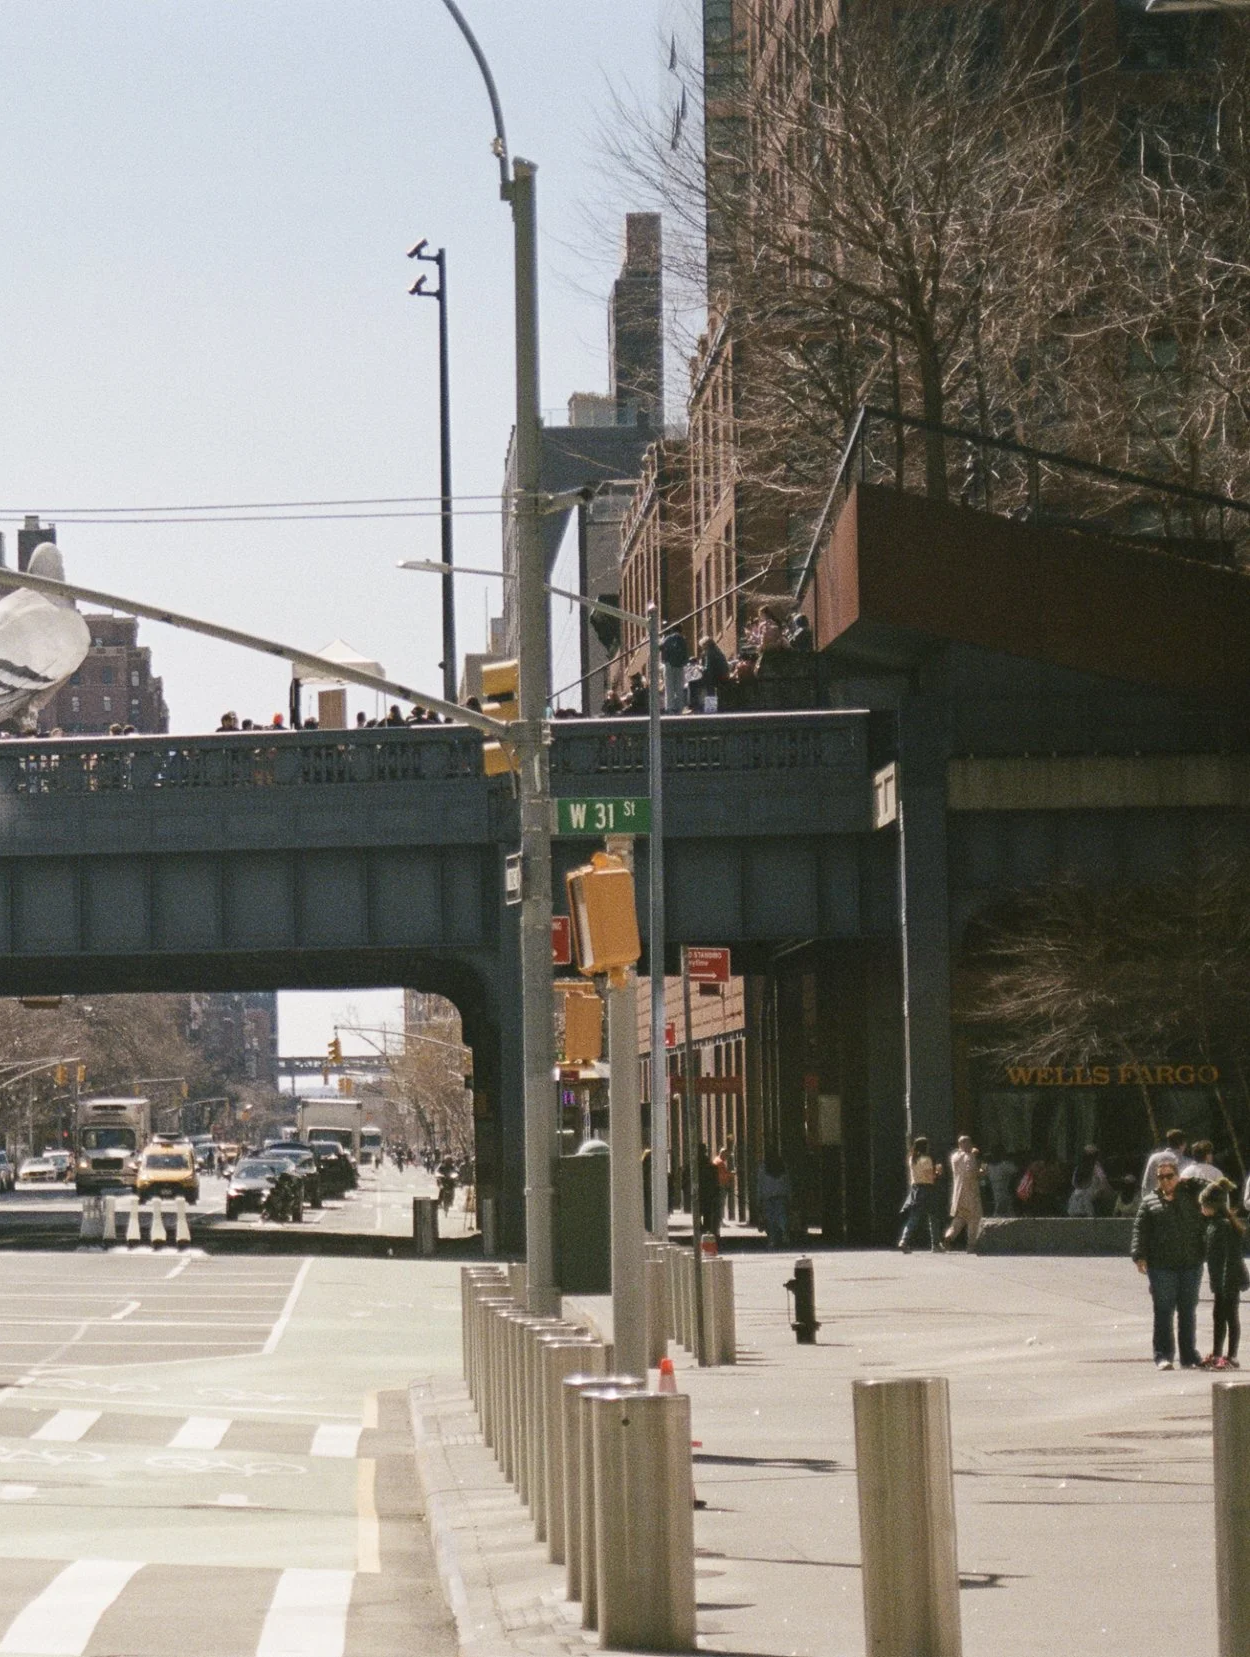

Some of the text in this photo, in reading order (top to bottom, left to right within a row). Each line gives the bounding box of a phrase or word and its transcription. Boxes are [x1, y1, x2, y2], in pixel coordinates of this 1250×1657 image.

[570, 801, 636, 830] W 31 St
[693, 951, 723, 959] STANDING
[1006, 1064, 1219, 1086] WELLS FARGO
